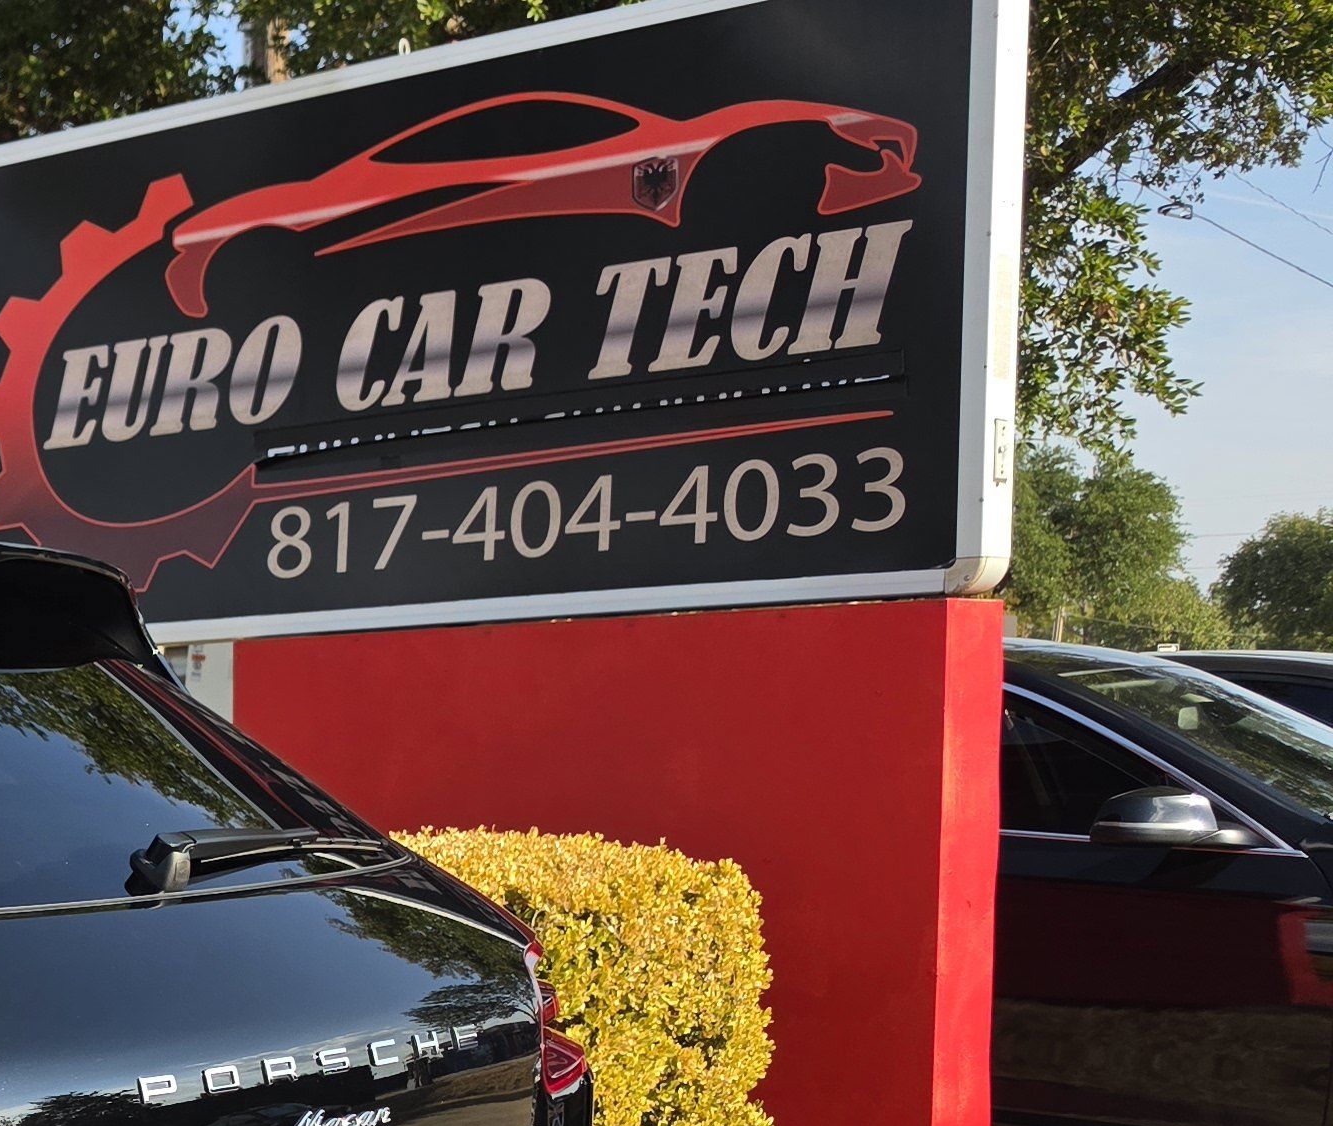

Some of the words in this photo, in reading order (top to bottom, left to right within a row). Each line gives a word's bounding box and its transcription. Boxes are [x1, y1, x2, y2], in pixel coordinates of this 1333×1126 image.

[43, 315, 303, 451] EURO
[335, 277, 551, 412] CAR
[588, 219, 914, 381] TECH
[267, 446, 907, 580] 817-404-4033
[137, 1024, 479, 1104] PORSCHE
